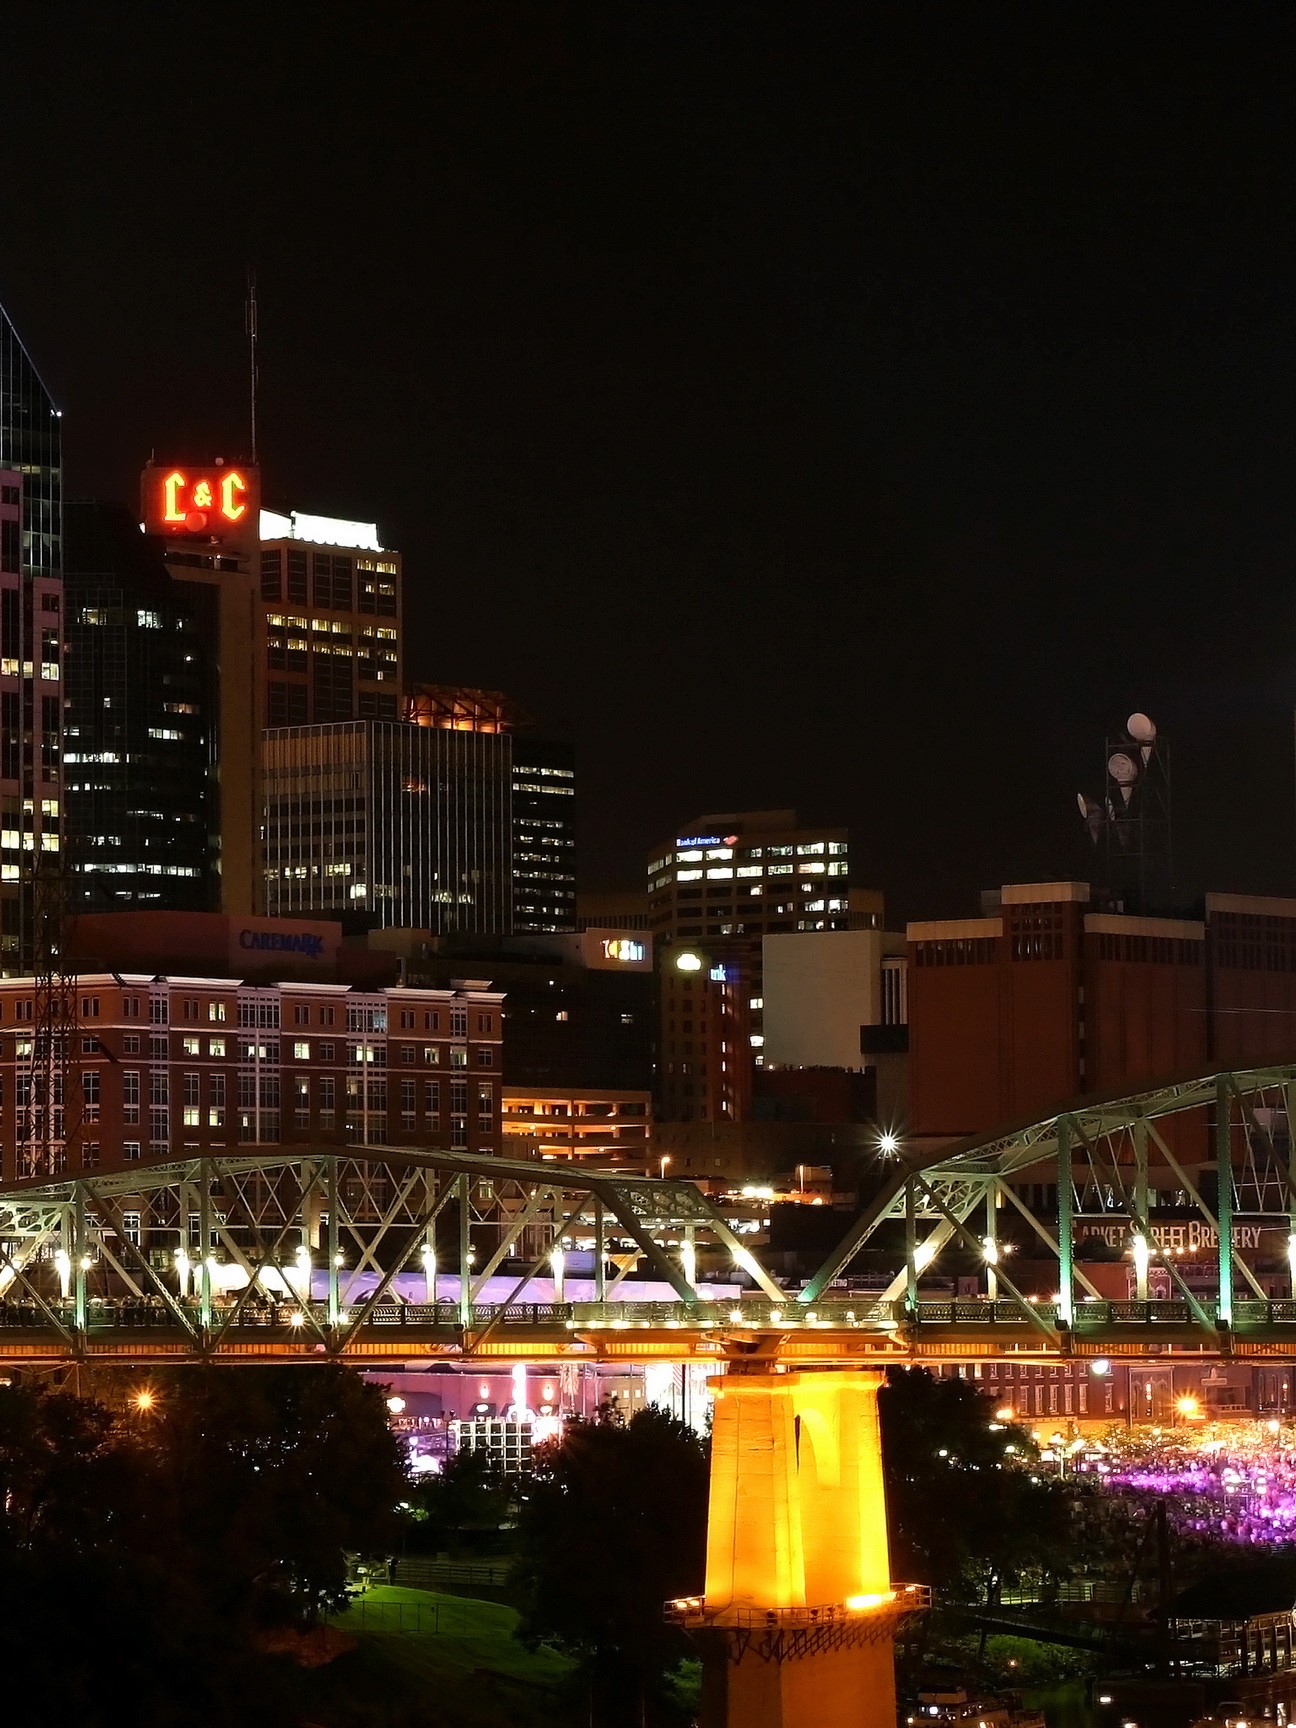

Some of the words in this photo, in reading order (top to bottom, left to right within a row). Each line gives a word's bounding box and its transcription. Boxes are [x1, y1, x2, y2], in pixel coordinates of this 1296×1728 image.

[1071, 1220, 1125, 1247] ARKET
[1130, 1219, 1185, 1248] SREET
[1189, 1220, 1261, 1248] BREERY
